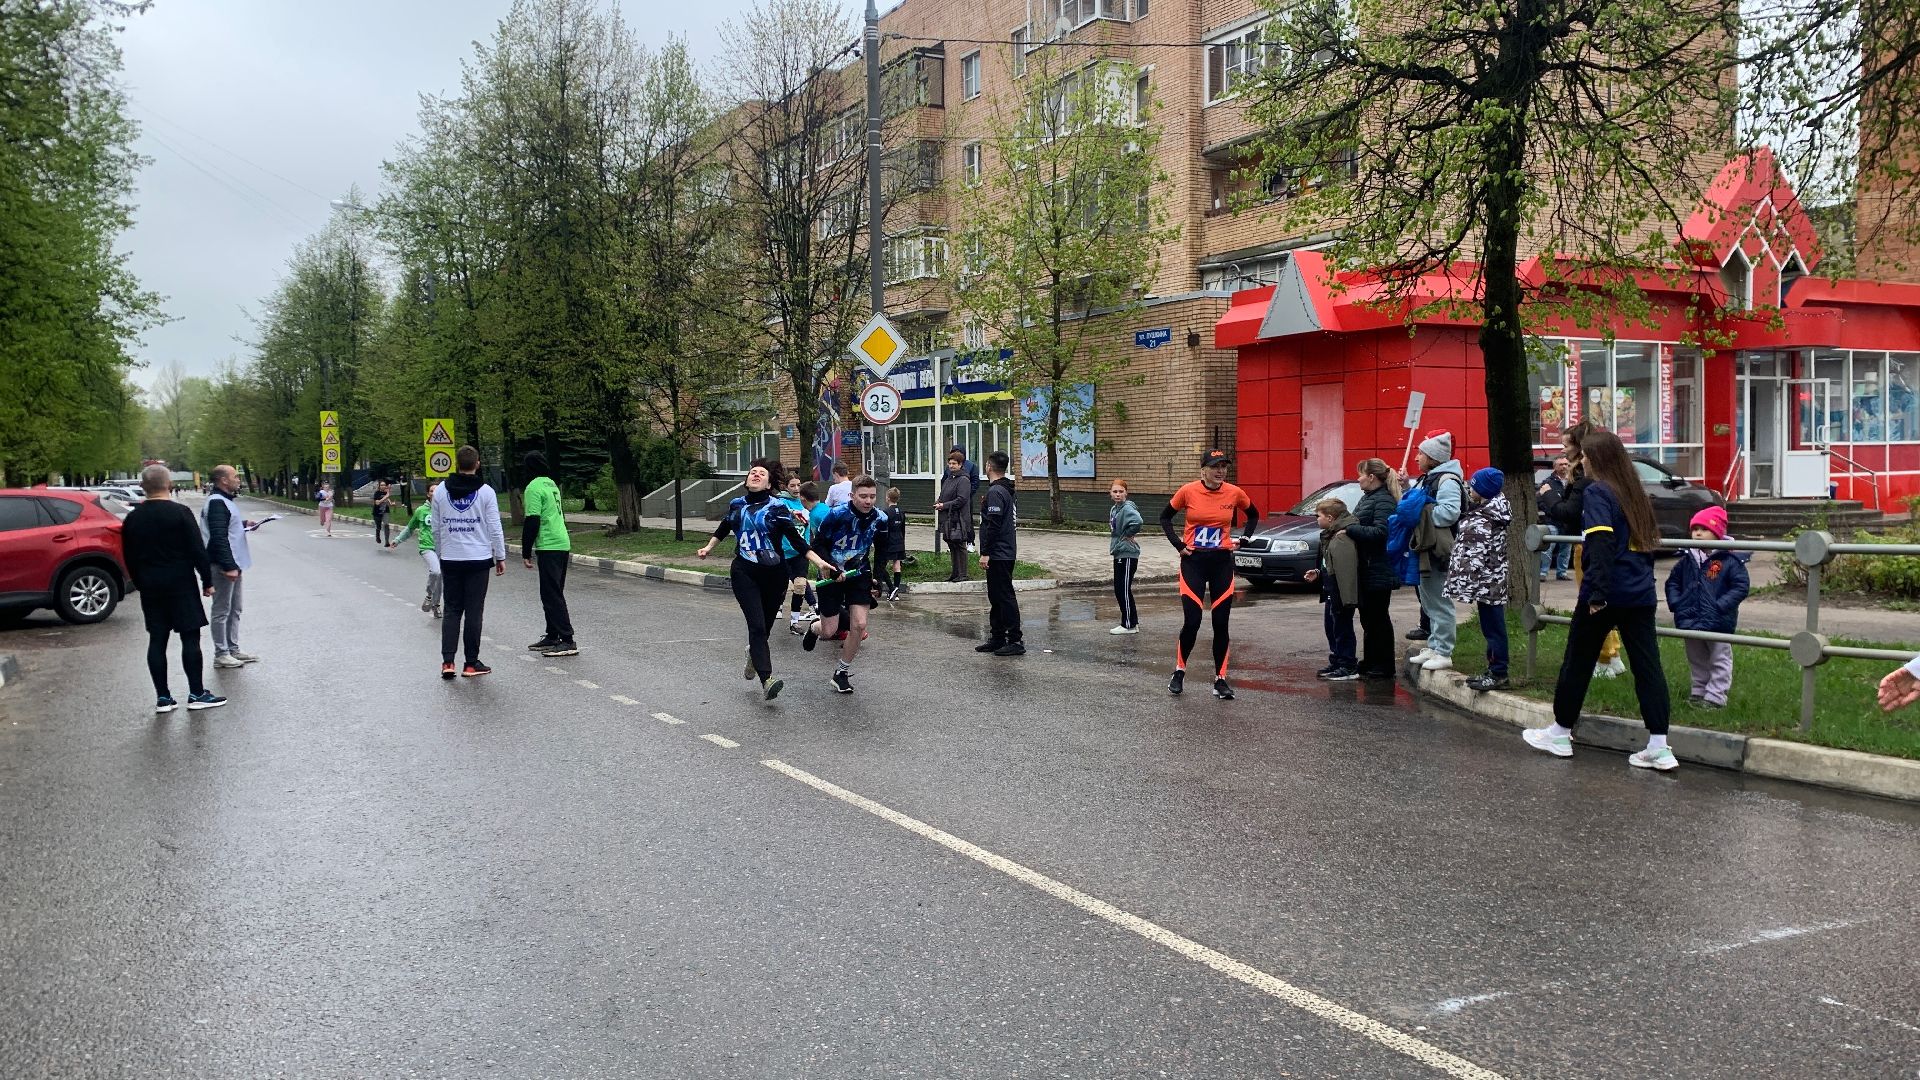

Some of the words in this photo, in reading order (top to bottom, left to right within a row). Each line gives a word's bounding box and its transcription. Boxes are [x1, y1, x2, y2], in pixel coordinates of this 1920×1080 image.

[1149, 339, 1156, 348] 21
[1662, 363, 1671, 440] ПЕЛЬМЕНИ
[433, 457, 449, 467] 40
[442, 516, 481, 526] Ступинский
[448, 525, 475, 534] филиал
[739, 529, 761, 551] 41
[834, 534, 859, 550] 41
[1194, 526, 1221, 547] 44
